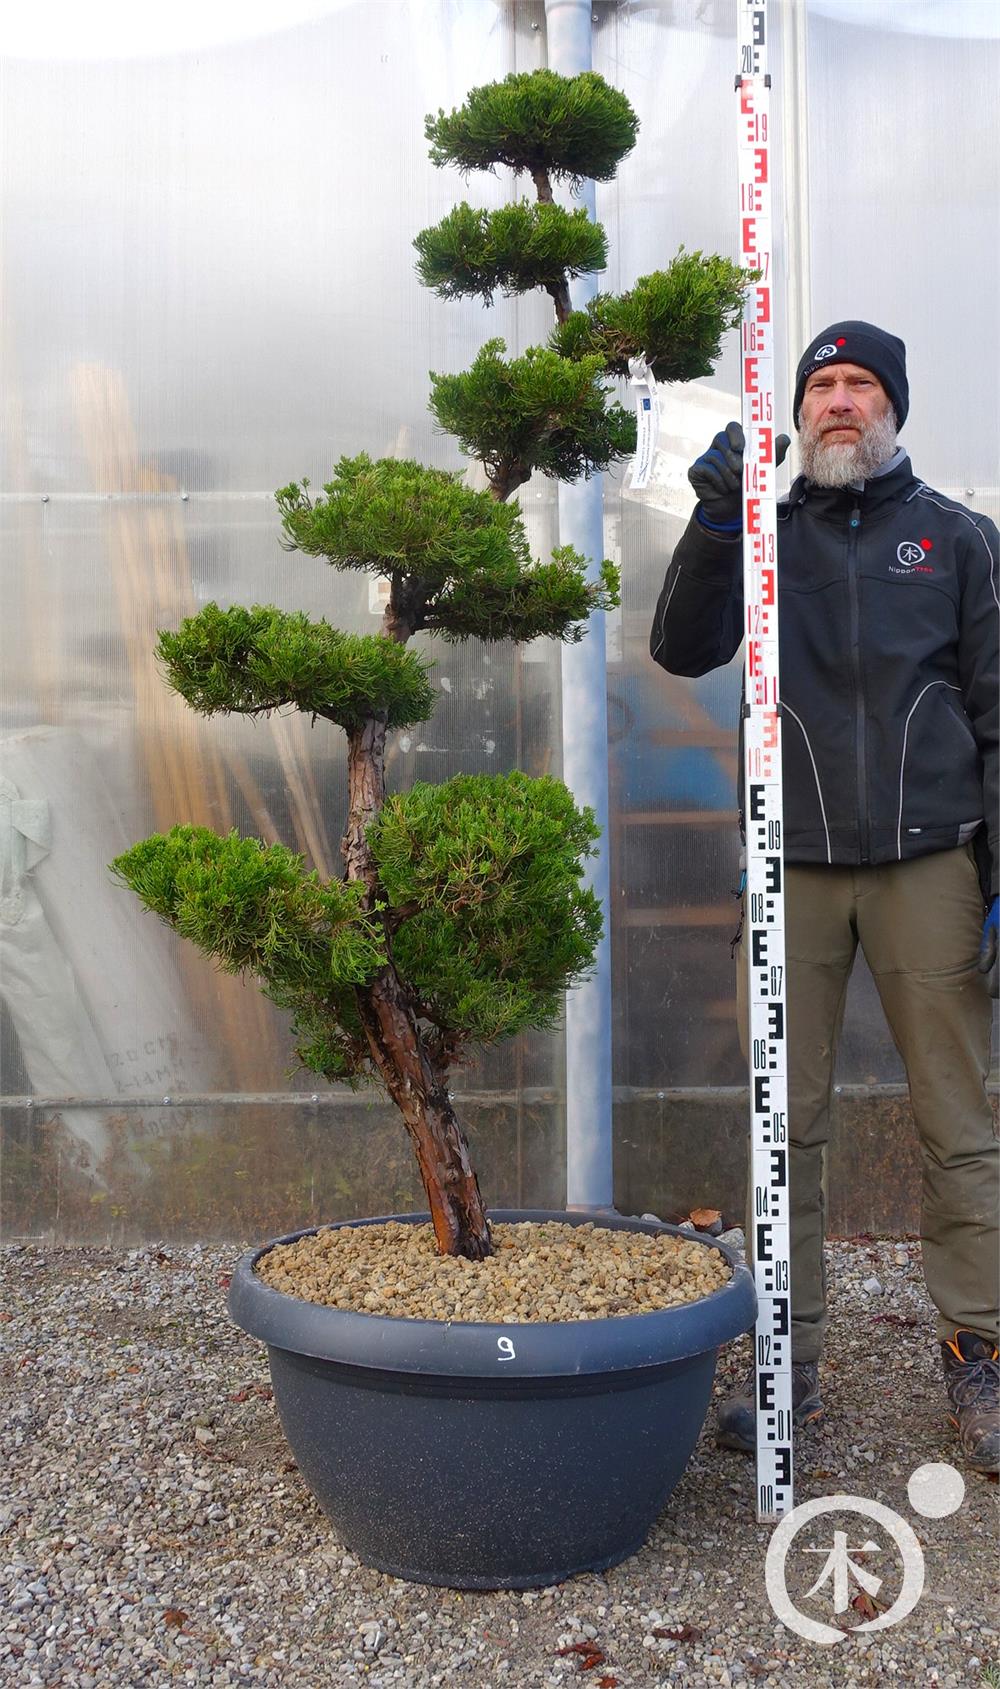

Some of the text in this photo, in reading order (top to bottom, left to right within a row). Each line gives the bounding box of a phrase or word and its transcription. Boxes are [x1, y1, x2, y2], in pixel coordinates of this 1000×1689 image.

[742, 45, 752, 73] 20
[755, 114, 767, 142] 19
[742, 183, 753, 211] 18
[757, 252, 770, 280] 17
[744, 322, 756, 351] 16
[760, 392, 772, 421] 15
[745, 464, 758, 492] 14
[762, 534, 774, 563] 13
[748, 605, 760, 634] 12
[764, 677, 777, 704] 11
[749, 748, 760, 777] 10
[768, 820, 780, 850] 09
[751, 893, 763, 923] 08
[771, 965, 783, 996] 07
[753, 1039, 766, 1069] 06
[773, 1112, 785, 1143] 05
[756, 1186, 768, 1217] 04
[775, 1260, 788, 1291] 03
[497, 1336, 516, 1361] 9
[758, 1335, 770, 1366] 02
[778, 1410, 791, 1441] 01
